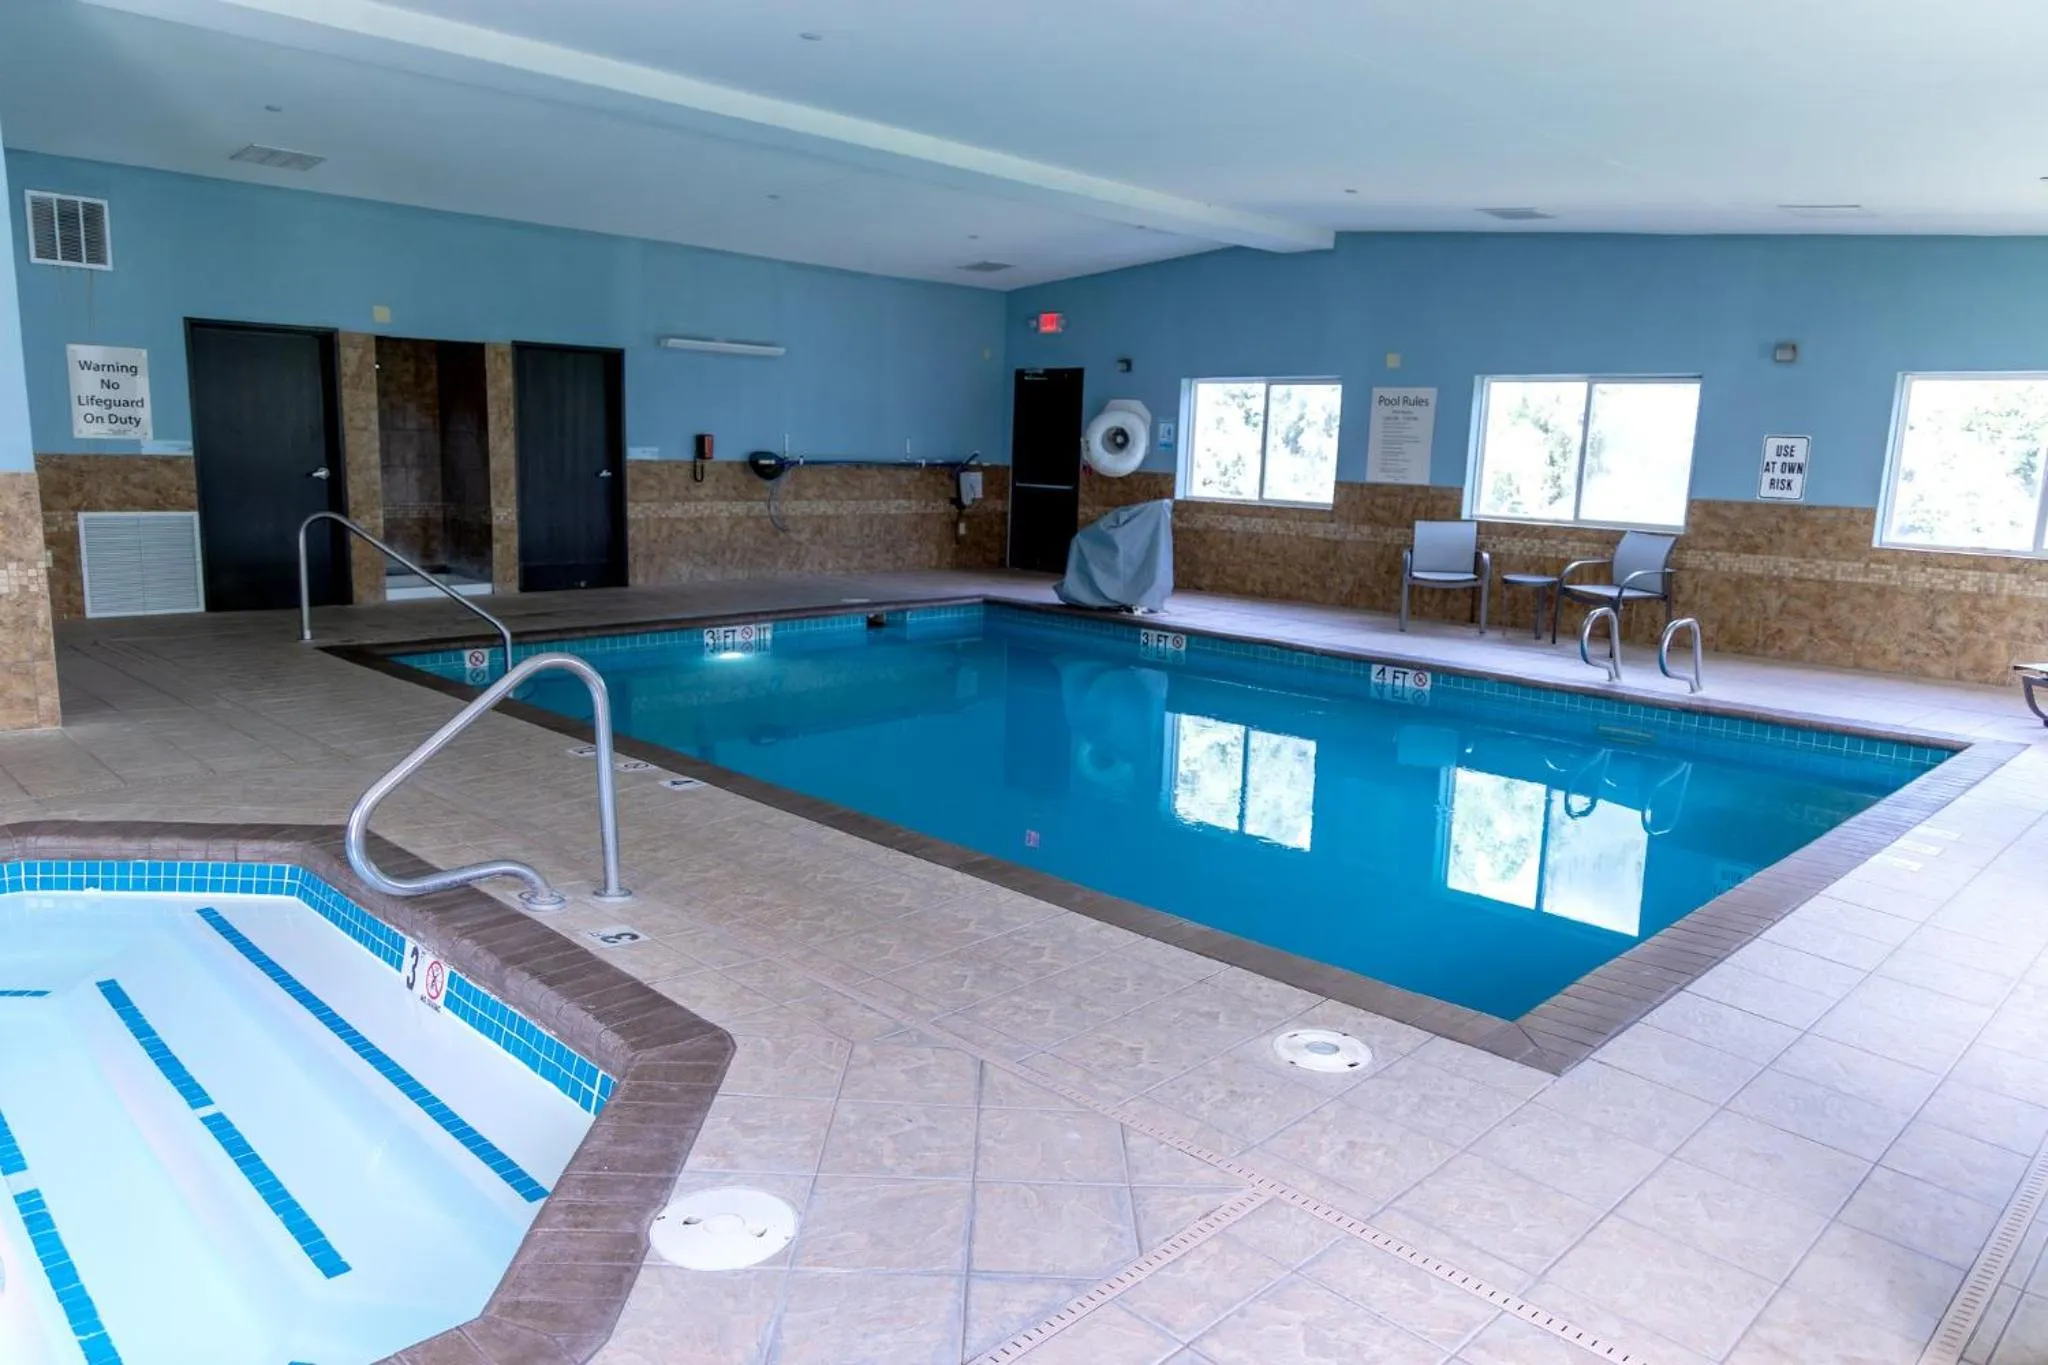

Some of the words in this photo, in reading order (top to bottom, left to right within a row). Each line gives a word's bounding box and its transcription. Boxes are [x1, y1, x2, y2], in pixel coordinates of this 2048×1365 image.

[78, 360, 138, 376] Warning
[100, 379, 120, 390] No
[77, 395, 144, 410] Lifeguard
[1378, 394, 1400, 407] Pool
[1403, 395, 1430, 407] Rules
[83, 412, 104, 424] On
[107, 413, 141, 428] Duty
[1776, 444, 1796, 458] USE
[1764, 461, 1777, 474] AT
[1780, 461, 1804, 475] OWN
[1769, 478, 1793, 491] RISK
[1142, 632, 1149, 645] 3
[1157, 634, 1169, 648] FT
[1393, 669, 1410, 687] FT
[600, 932, 639, 944] 3
[406, 945, 419, 991] 3
